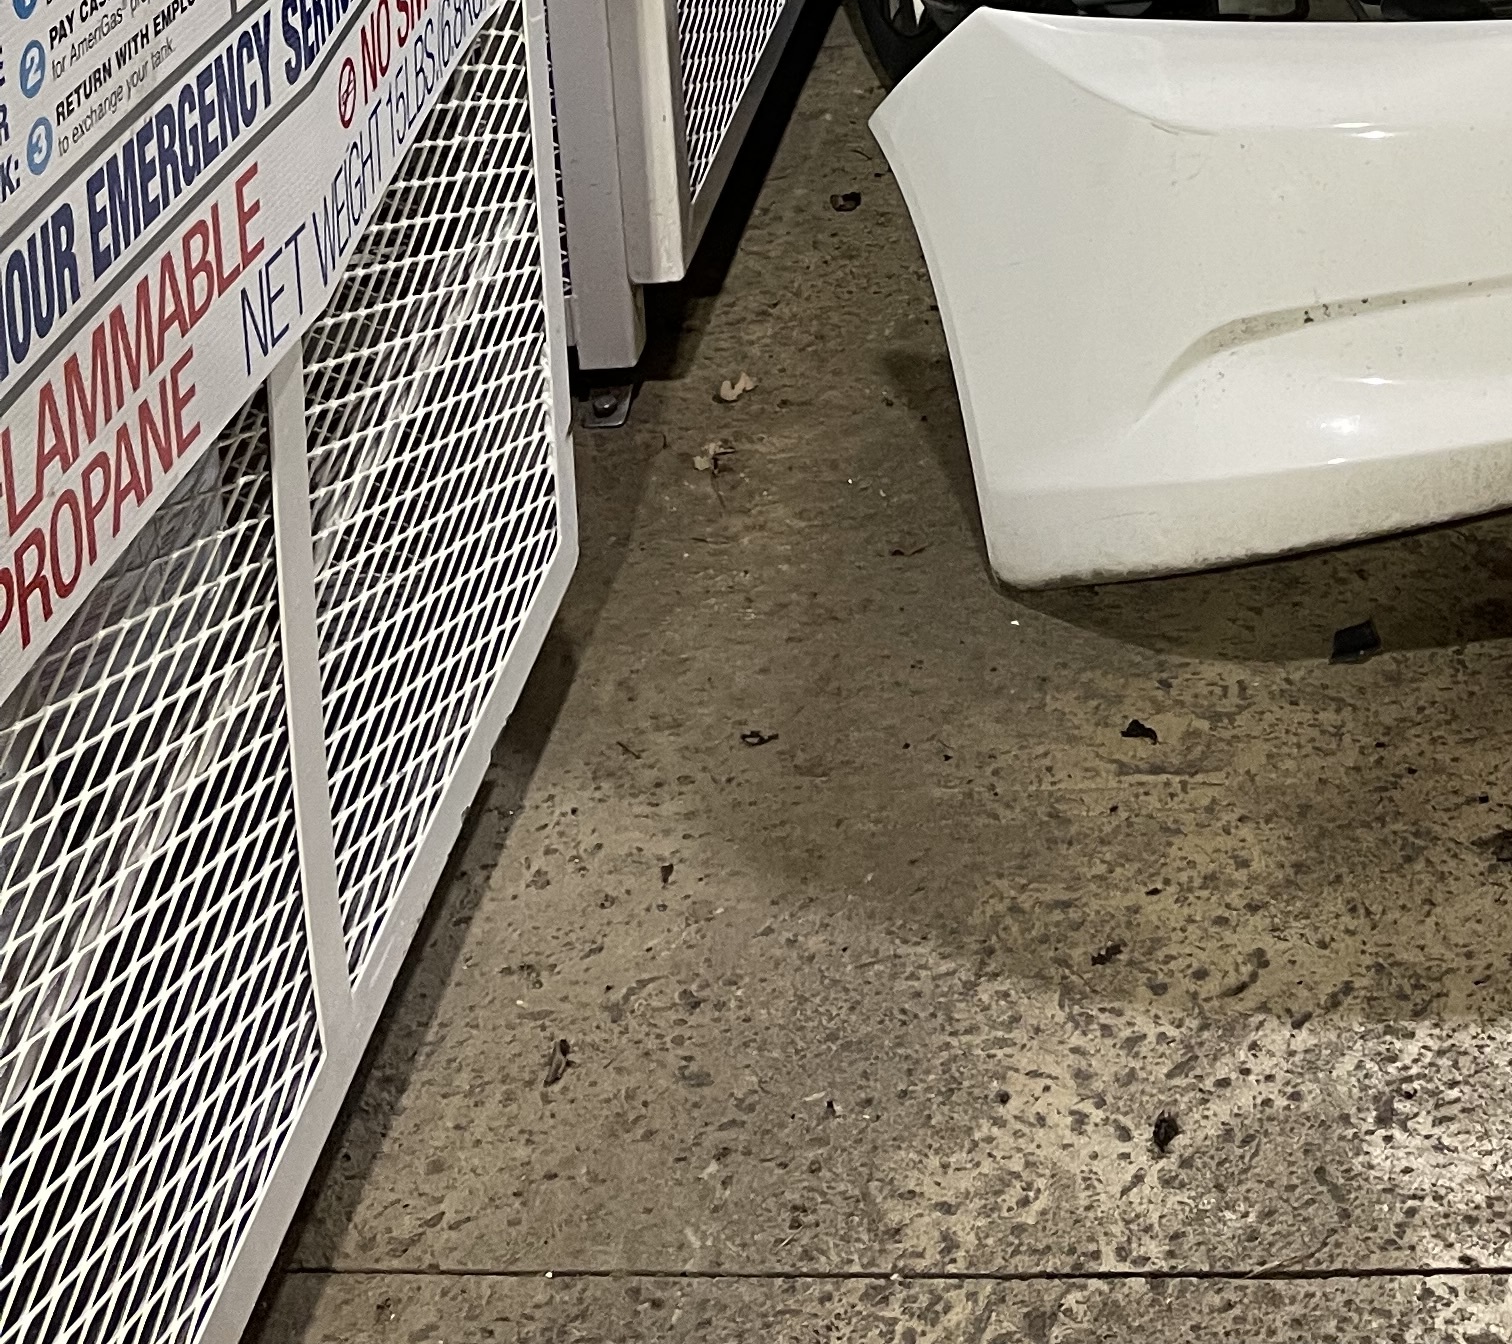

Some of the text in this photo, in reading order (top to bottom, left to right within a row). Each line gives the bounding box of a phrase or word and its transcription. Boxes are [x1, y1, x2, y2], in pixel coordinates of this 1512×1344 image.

[49, 14, 75, 50] PAY
[51, 54, 68, 82] for
[55, 59, 113, 127] RETURN
[116, 28, 150, 67] WITH
[57, 134, 70, 157] to
[71, 83, 124, 144] exchange
[126, 62, 150, 102] your
[86, 9, 271, 282] EMERGENCY
[240, 222, 307, 377] NET
[311, 103, 382, 289] WEIGHT
[0, 162, 265, 539] LAMMABLE
